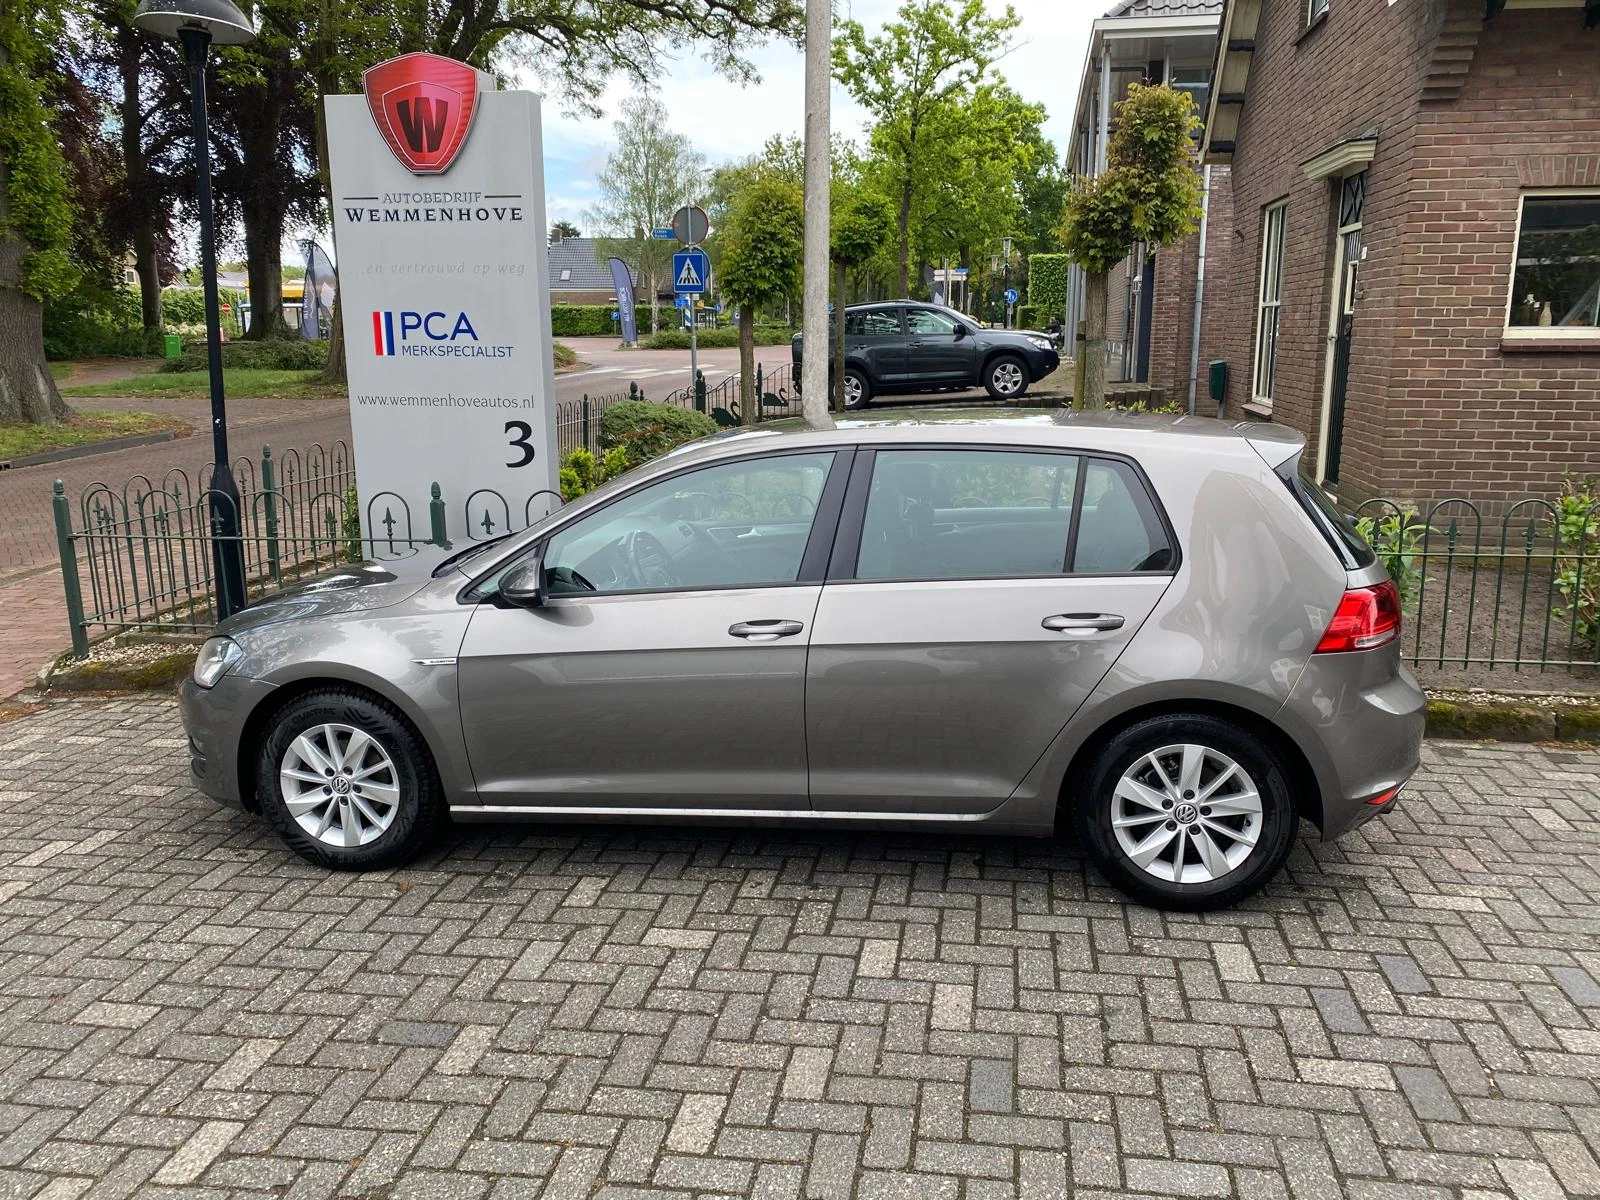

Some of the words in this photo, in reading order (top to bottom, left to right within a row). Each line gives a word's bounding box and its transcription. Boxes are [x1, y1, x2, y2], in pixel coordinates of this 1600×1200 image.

[396, 97, 448, 153] W
[383, 192, 482, 204] AUTOBEDRIJF
[344, 207, 523, 223] WEMMENHOVE
[391, 261, 465, 275] vertrouwd
[472, 263, 490, 276] op
[498, 262, 526, 275] weg
[400, 311, 479, 341] PCA
[401, 345, 514, 358] MERKSPECIALIST
[357, 394, 535, 409] www.wemmenhoveautos.nl
[504, 420, 536, 469] 3
